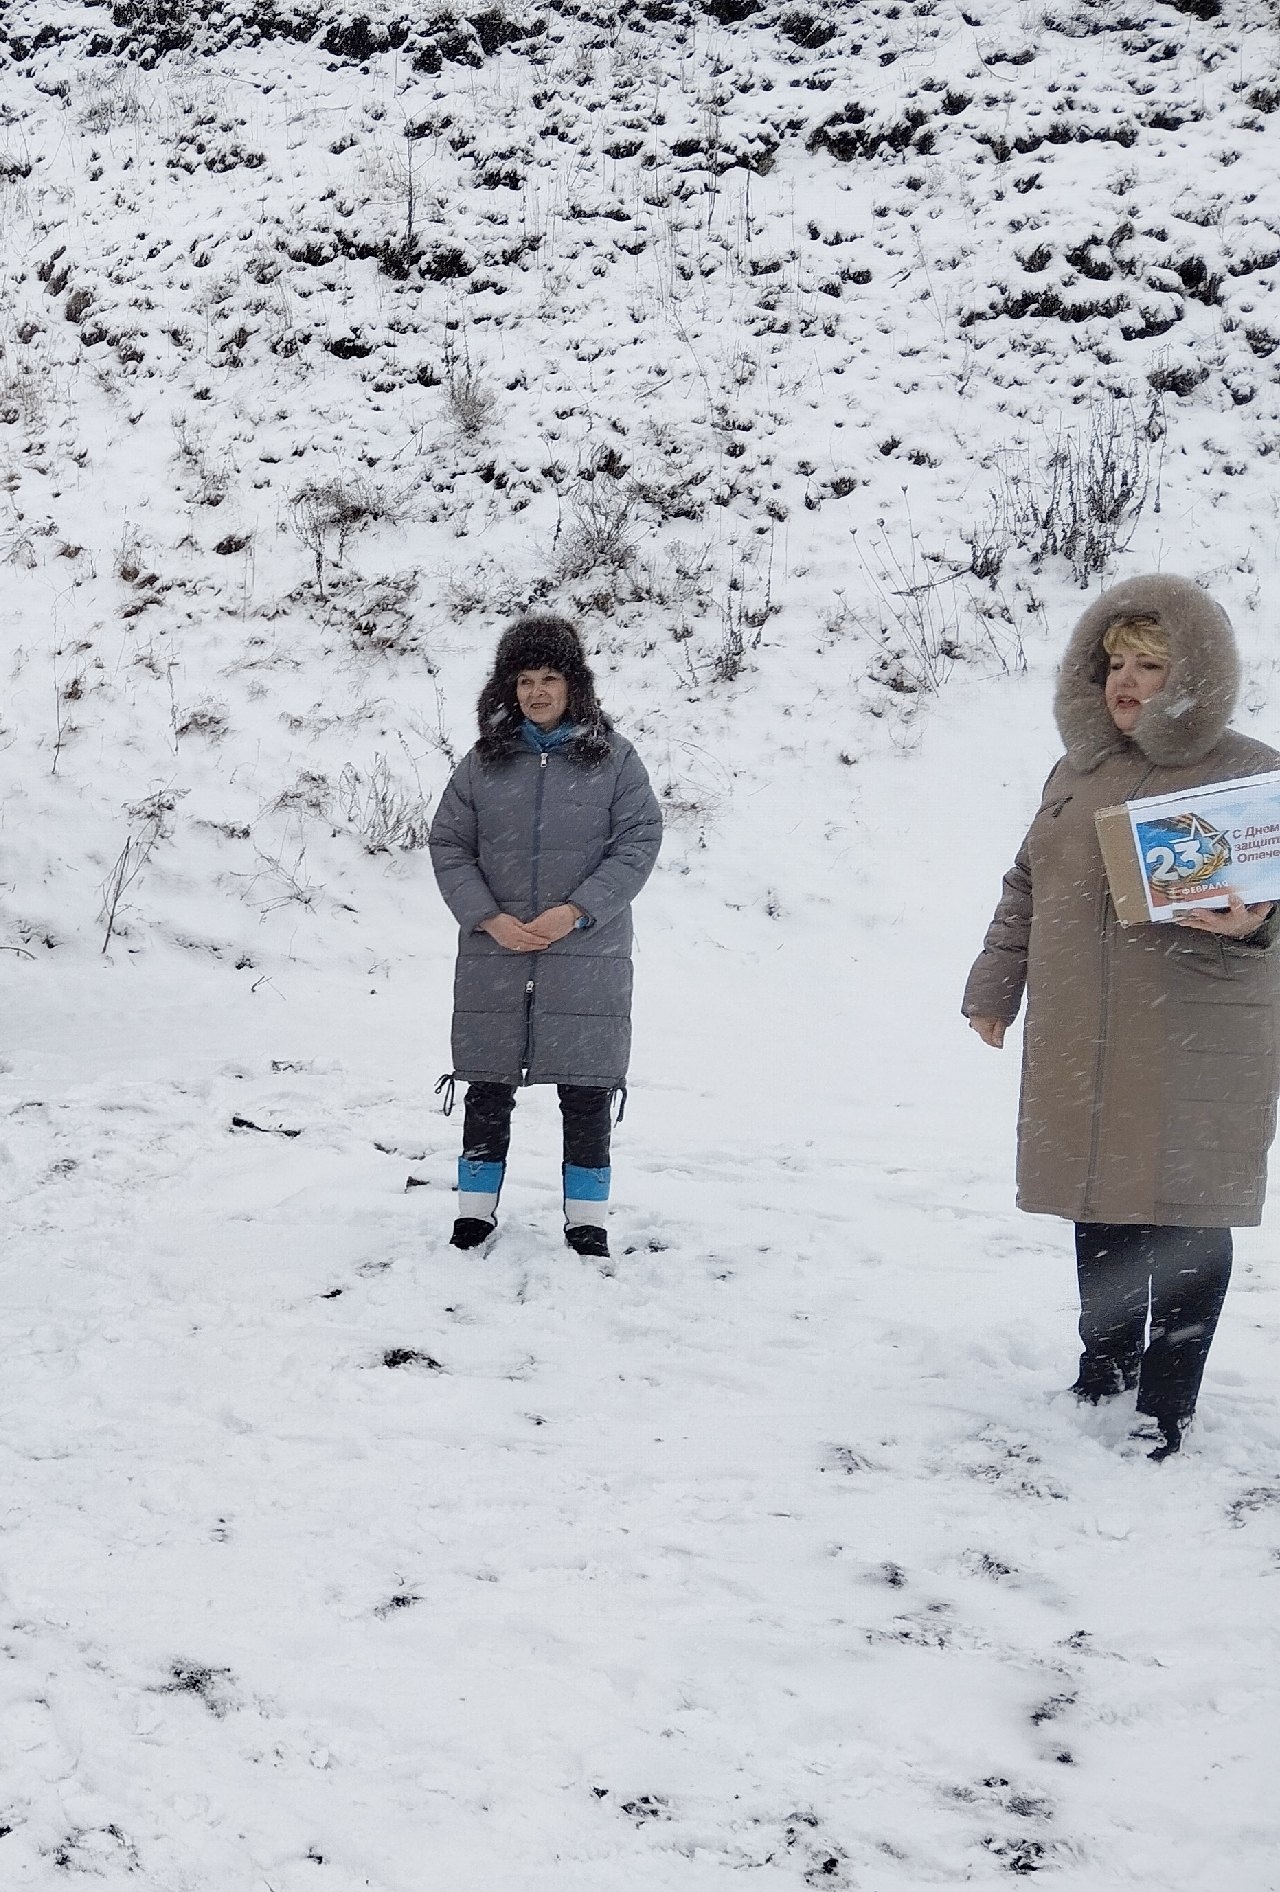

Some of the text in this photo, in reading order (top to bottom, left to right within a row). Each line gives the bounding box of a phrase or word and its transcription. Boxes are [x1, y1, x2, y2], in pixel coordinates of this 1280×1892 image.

[1232, 829, 1242, 839] С
[1147, 840, 1204, 881] 23
[1181, 880, 1229, 895] ФЕВРАЛЯ
